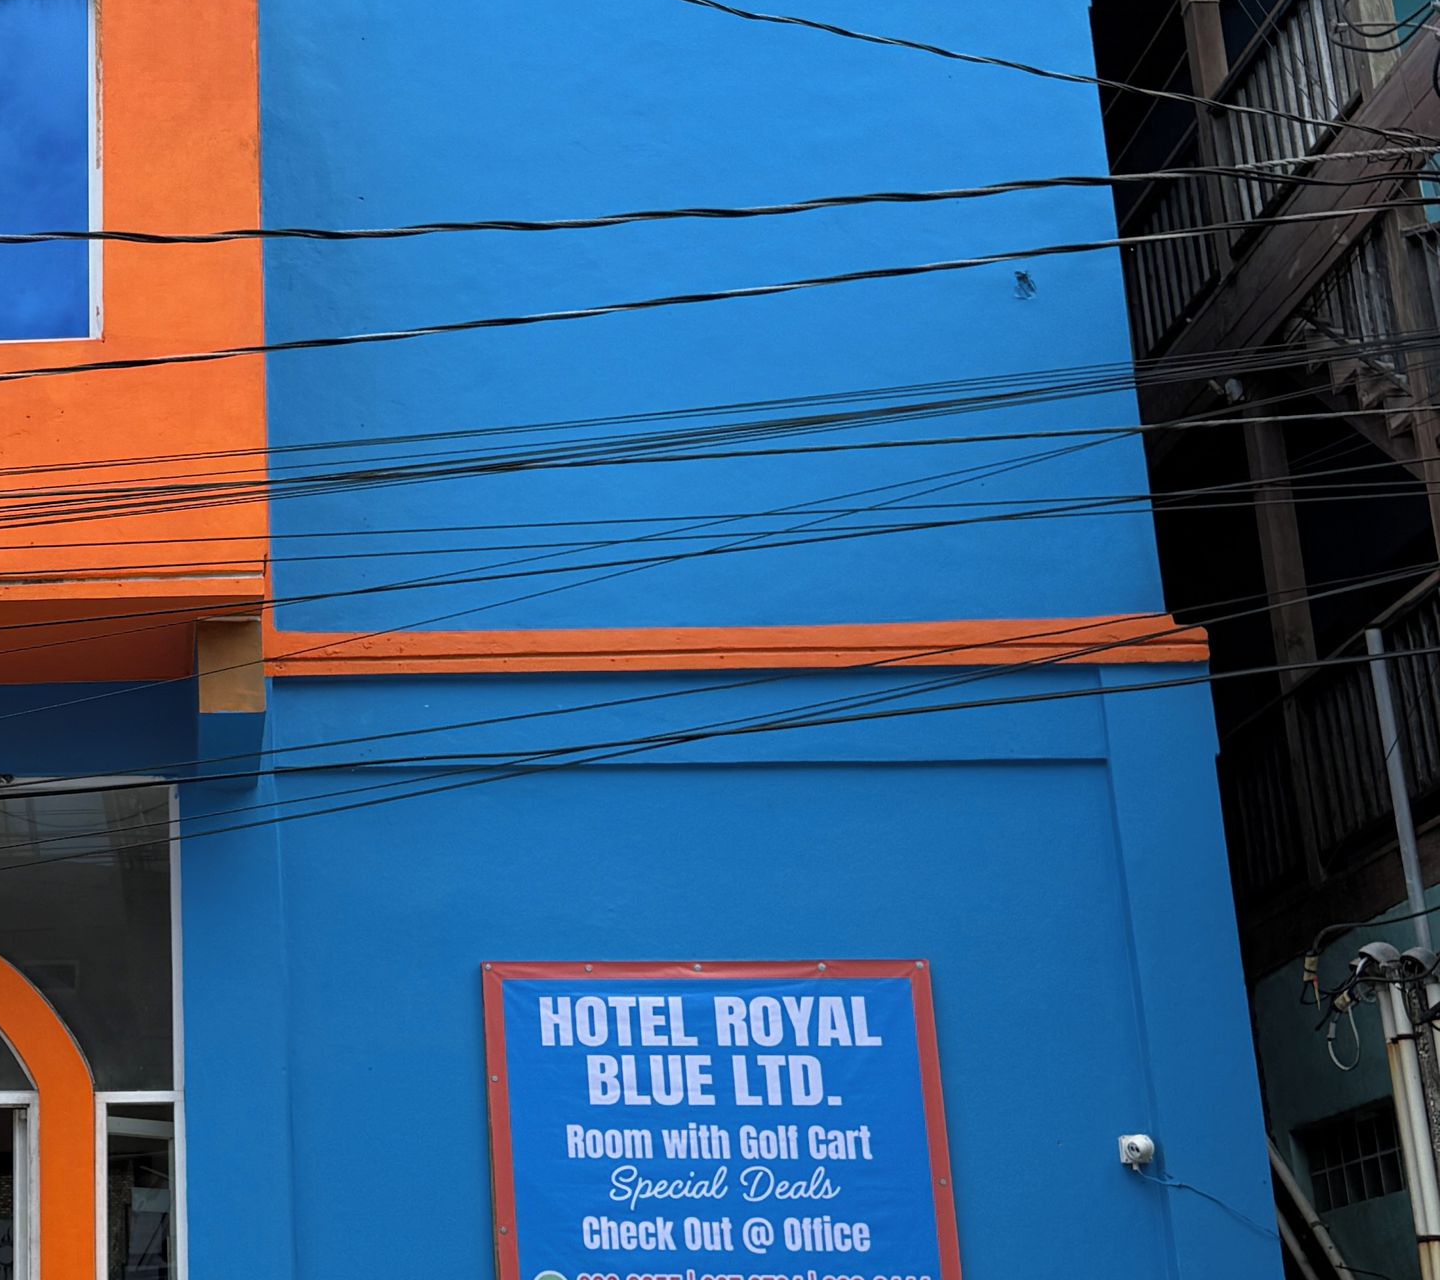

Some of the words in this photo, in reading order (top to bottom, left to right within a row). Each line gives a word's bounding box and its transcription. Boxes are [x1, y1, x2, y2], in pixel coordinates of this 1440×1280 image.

[538, 996, 698, 1046] HOTEL
[714, 996, 882, 1046] ROYAL
[587, 1054, 716, 1106] BLUE
[731, 1054, 842, 1106] LTD.
[566, 1123, 653, 1159] Room
[662, 1122, 730, 1160] with
[739, 1125, 799, 1160] Golf
[807, 1124, 873, 1161] Cart
[609, 1165, 728, 1210] Special
[740, 1166, 841, 1202] Deals
[582, 1216, 676, 1252] Check
[684, 1217, 733, 1252] Out
[743, 1217, 774, 1254] @
[783, 1216, 871, 1252] Office
